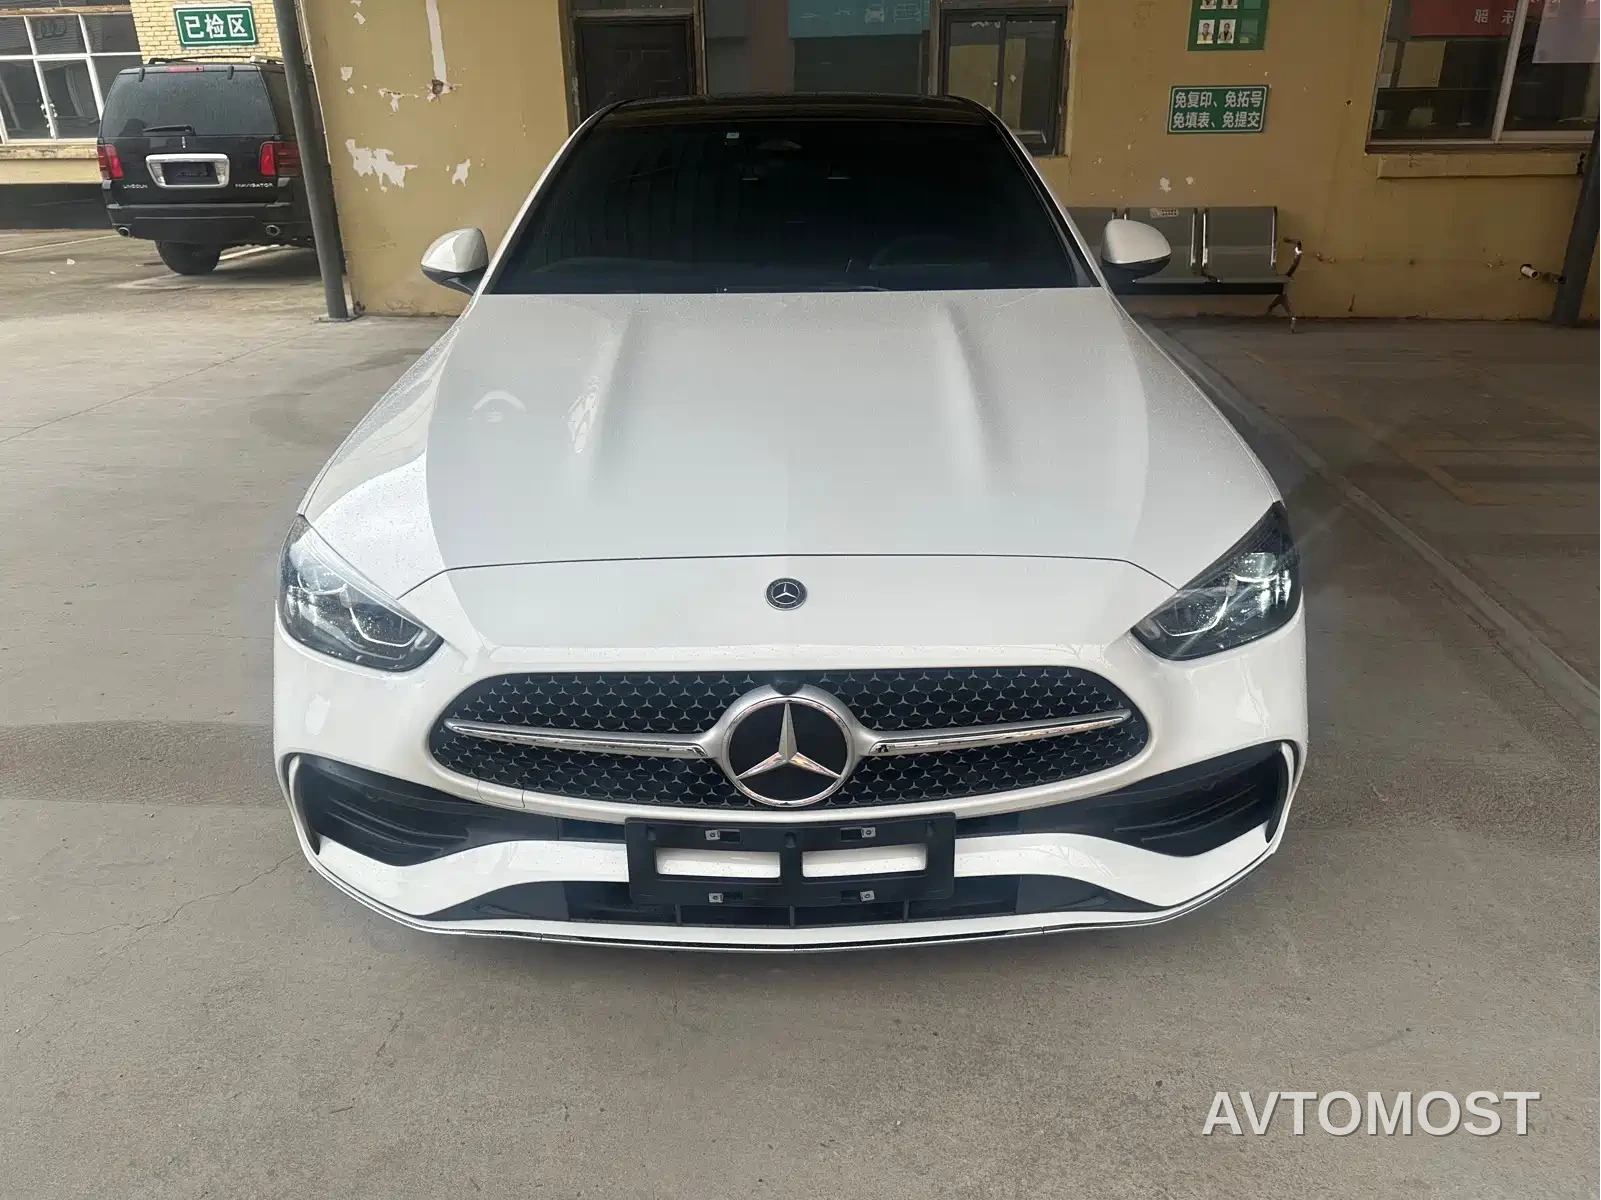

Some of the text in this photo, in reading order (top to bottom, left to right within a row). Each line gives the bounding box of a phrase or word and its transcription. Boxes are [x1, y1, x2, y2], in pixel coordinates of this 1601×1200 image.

[184, 13, 248, 38] 已检区
[1175, 90, 1263, 109] 免复印、免拓号
[1172, 111, 1260, 128] 免填表、免提交
